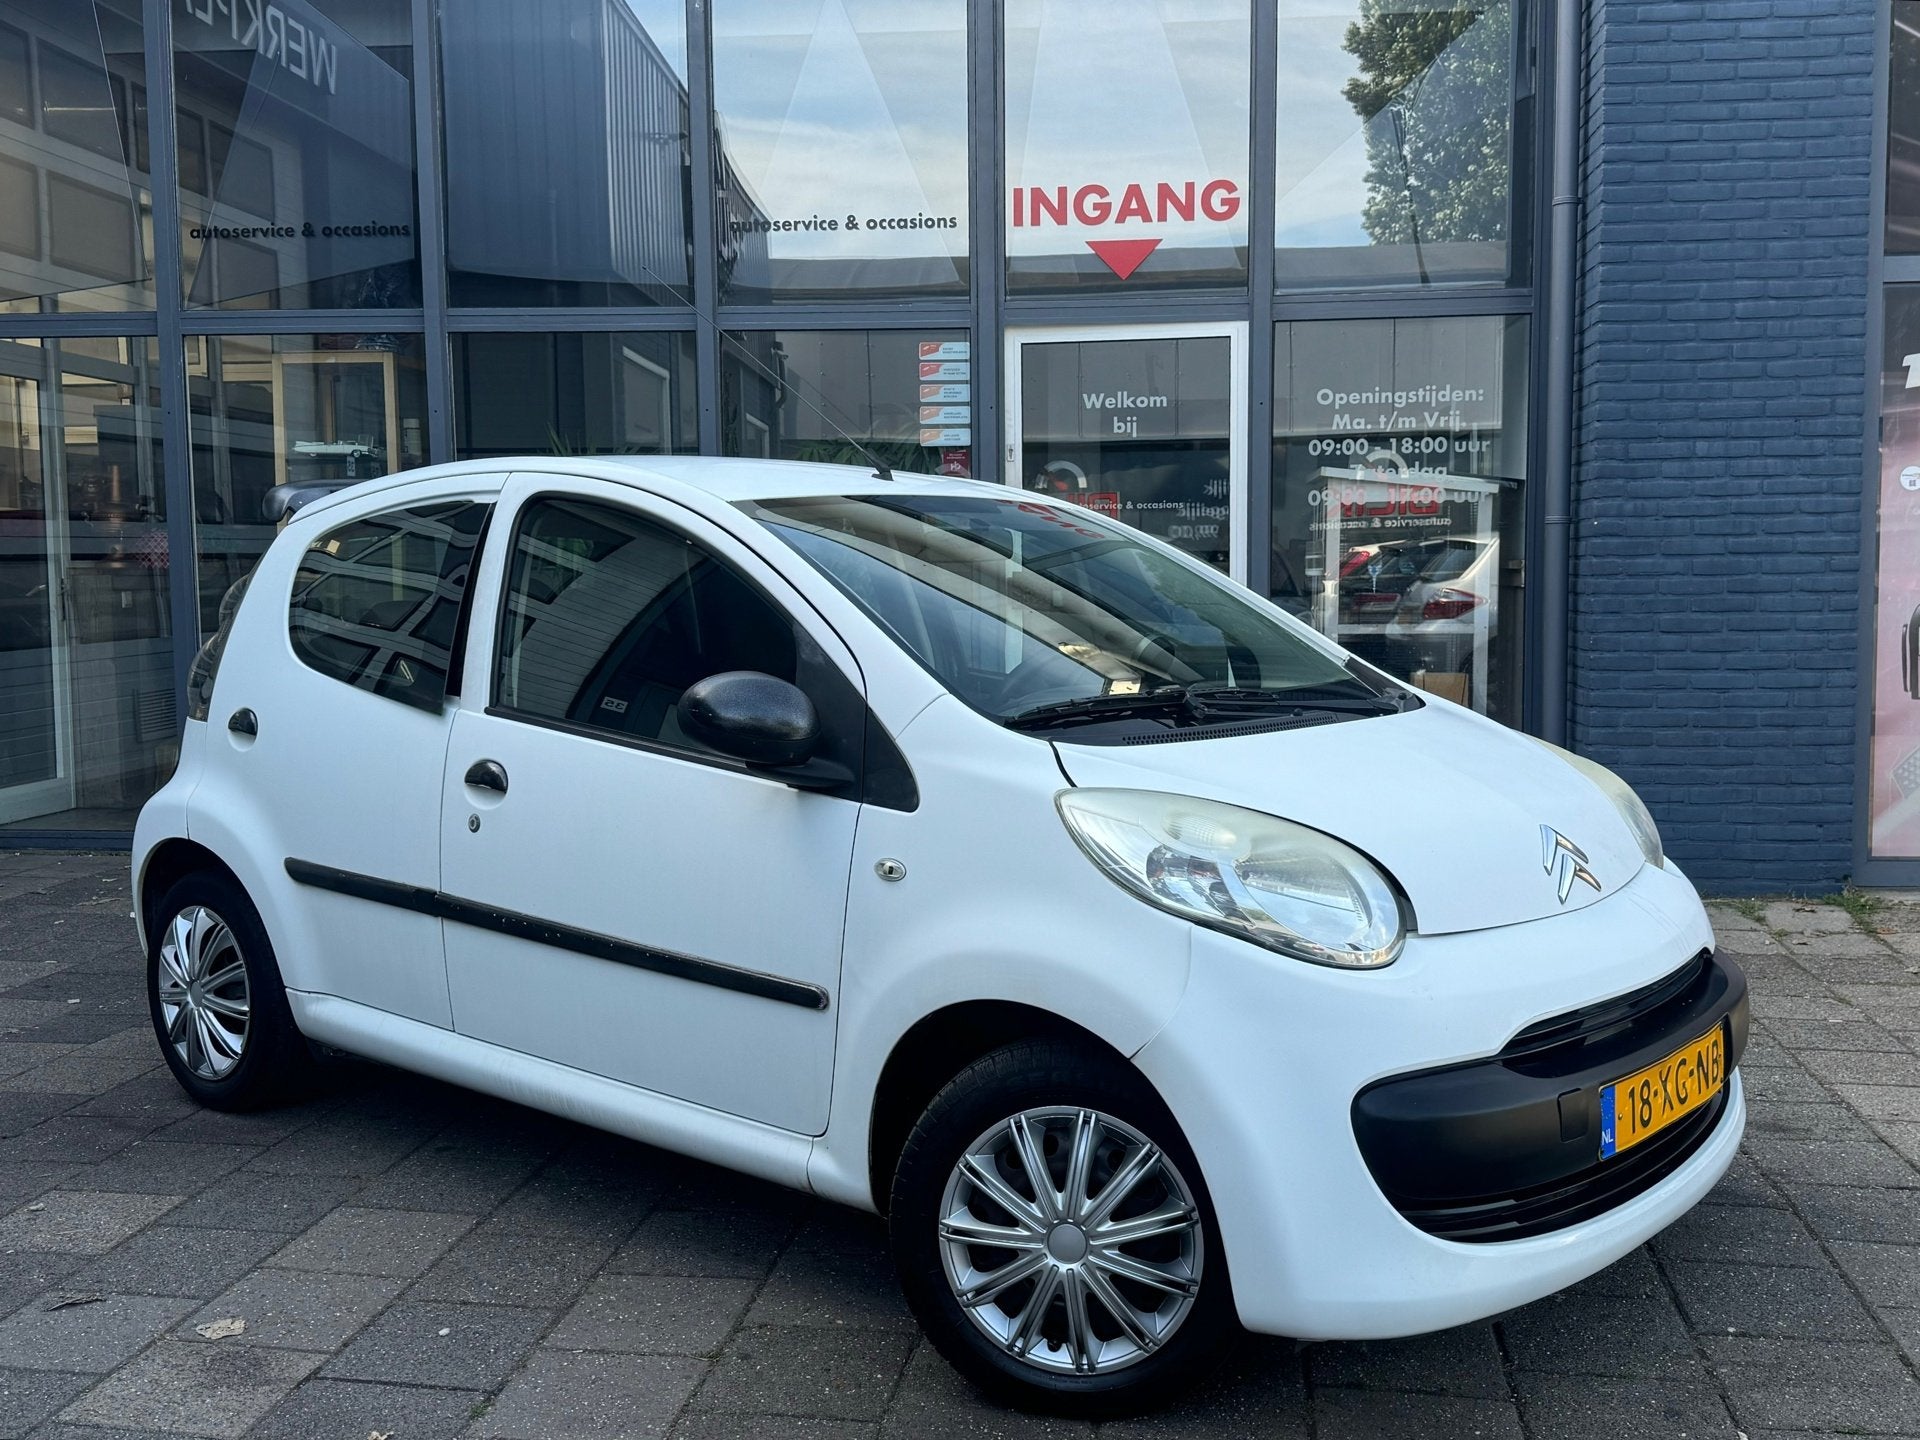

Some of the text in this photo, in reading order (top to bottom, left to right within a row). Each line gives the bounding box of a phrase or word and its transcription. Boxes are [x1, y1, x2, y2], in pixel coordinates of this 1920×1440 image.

[1013, 179, 1240, 227] INGANG
[189, 220, 410, 240] autoservice & occasions
[730, 212, 957, 232] autoservice & occasions
[1082, 391, 1168, 409] Welkom
[1316, 384, 1484, 409] Openingstijden:
[1113, 416, 1138, 438] bij
[1332, 410, 1467, 432] Ma. t/m Vrij.
[1308, 438, 1369, 456] 09:00
[1389, 436, 1448, 454] 18:00
[1454, 440, 1491, 453] uur
[1126, 501, 1134, 510] &
[1137, 500, 1184, 510] occasions
[1628, 1038, 1720, 1135] 18-XG-NB
[1602, 1128, 1613, 1145] NL
